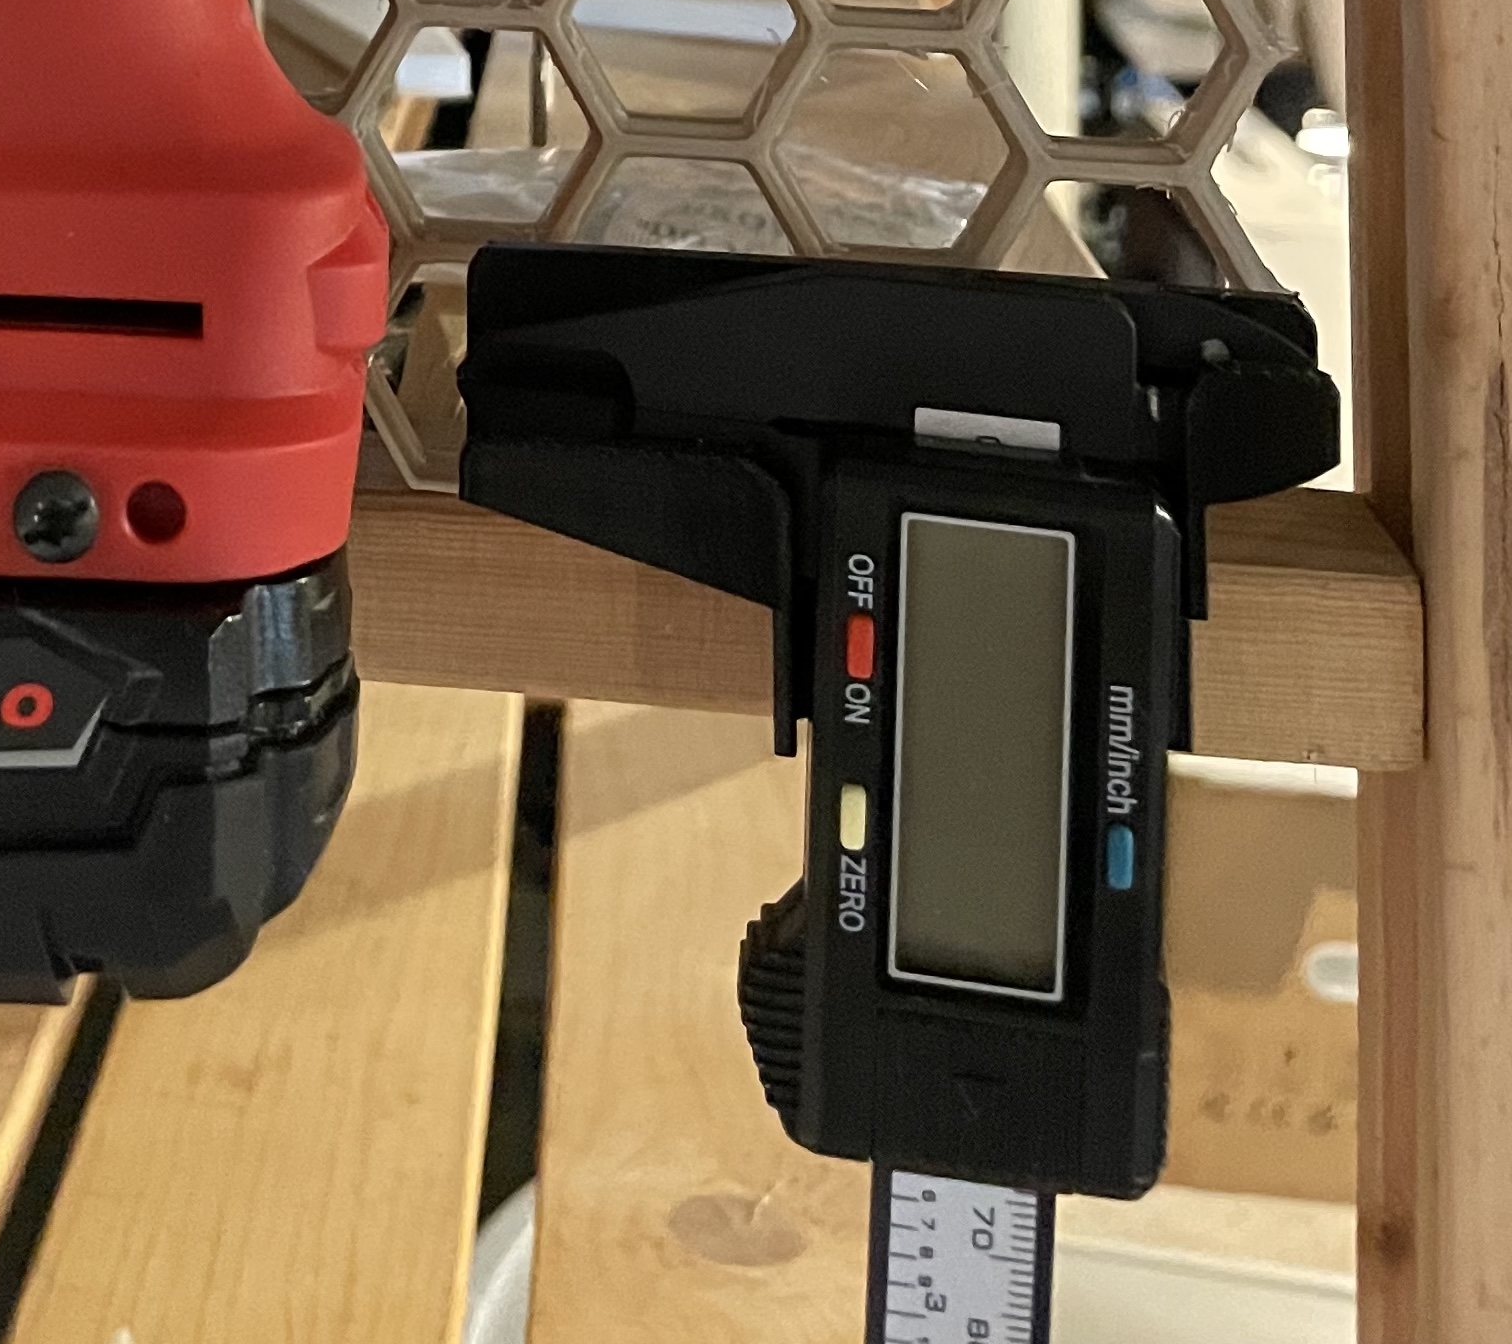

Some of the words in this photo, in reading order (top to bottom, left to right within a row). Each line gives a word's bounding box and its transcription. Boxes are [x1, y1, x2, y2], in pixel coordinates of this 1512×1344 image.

[848, 553, 875, 610] OFF
[844, 682, 872, 725] ON
[1106, 684, 1141, 815] mm/inch
[839, 854, 867, 933] ZERO
[921, 1218, 935, 1230] 7
[971, 1207, 995, 1251] 70
[925, 1292, 947, 1313] 3
